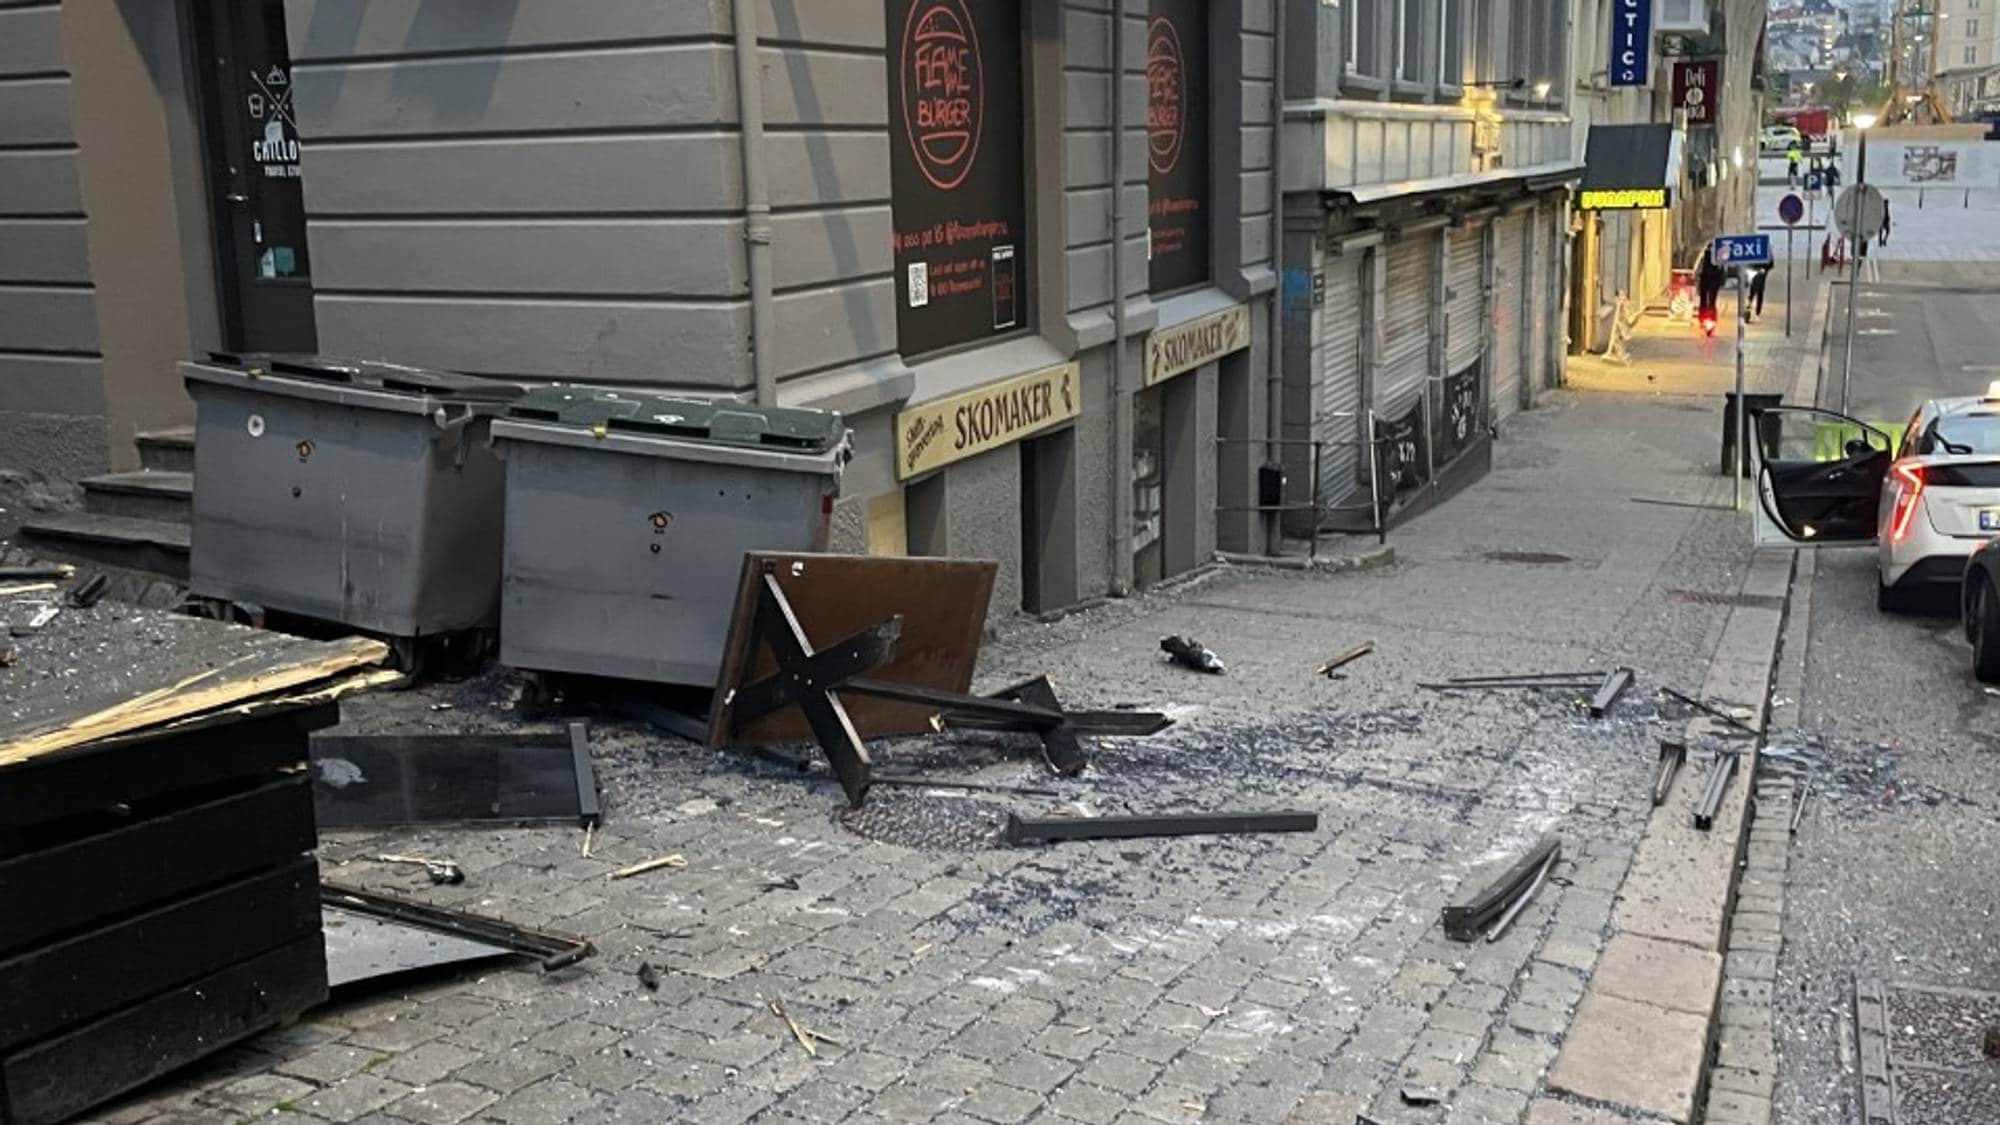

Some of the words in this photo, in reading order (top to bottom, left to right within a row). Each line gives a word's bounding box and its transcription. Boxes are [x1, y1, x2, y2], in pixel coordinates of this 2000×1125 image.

[1685, 66, 1705, 87] Deli
[917, 98, 971, 127] BURGER
[253, 140, 301, 161] CHILLO
[1807, 175, 1818, 190] P
[1721, 238, 1761, 256] Taxi
[1164, 322, 1222, 371] SKOMAKER
[954, 380, 1052, 449] SKOMAKER
